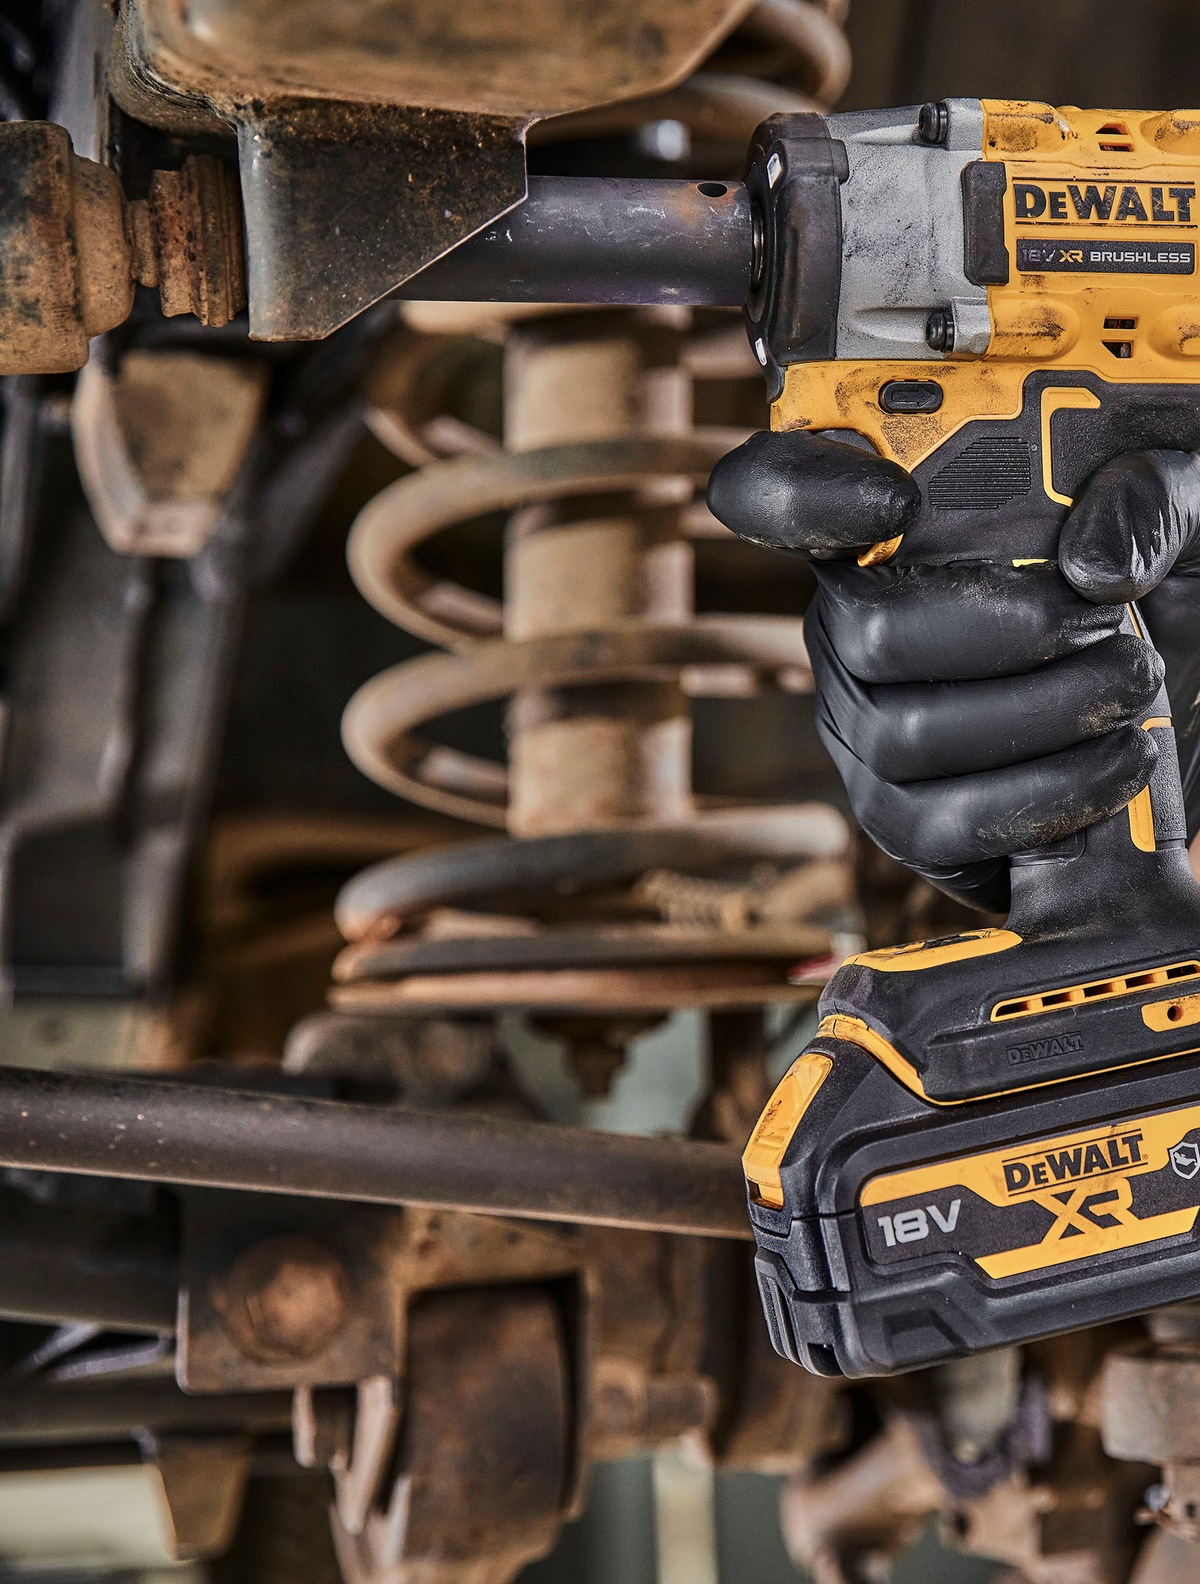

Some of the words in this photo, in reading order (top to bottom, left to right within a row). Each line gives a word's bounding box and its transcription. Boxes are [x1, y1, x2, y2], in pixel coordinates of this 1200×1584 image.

[1012, 183, 1197, 222] DEWALT
[1059, 249, 1083, 263] XR
[1090, 251, 1191, 264] BRUSHLESS
[1006, 1034, 1083, 1066] DEWALT
[1003, 1132, 1144, 1193] DEWALT
[877, 1198, 961, 1247] 18V
[1034, 1177, 1142, 1246] XR
